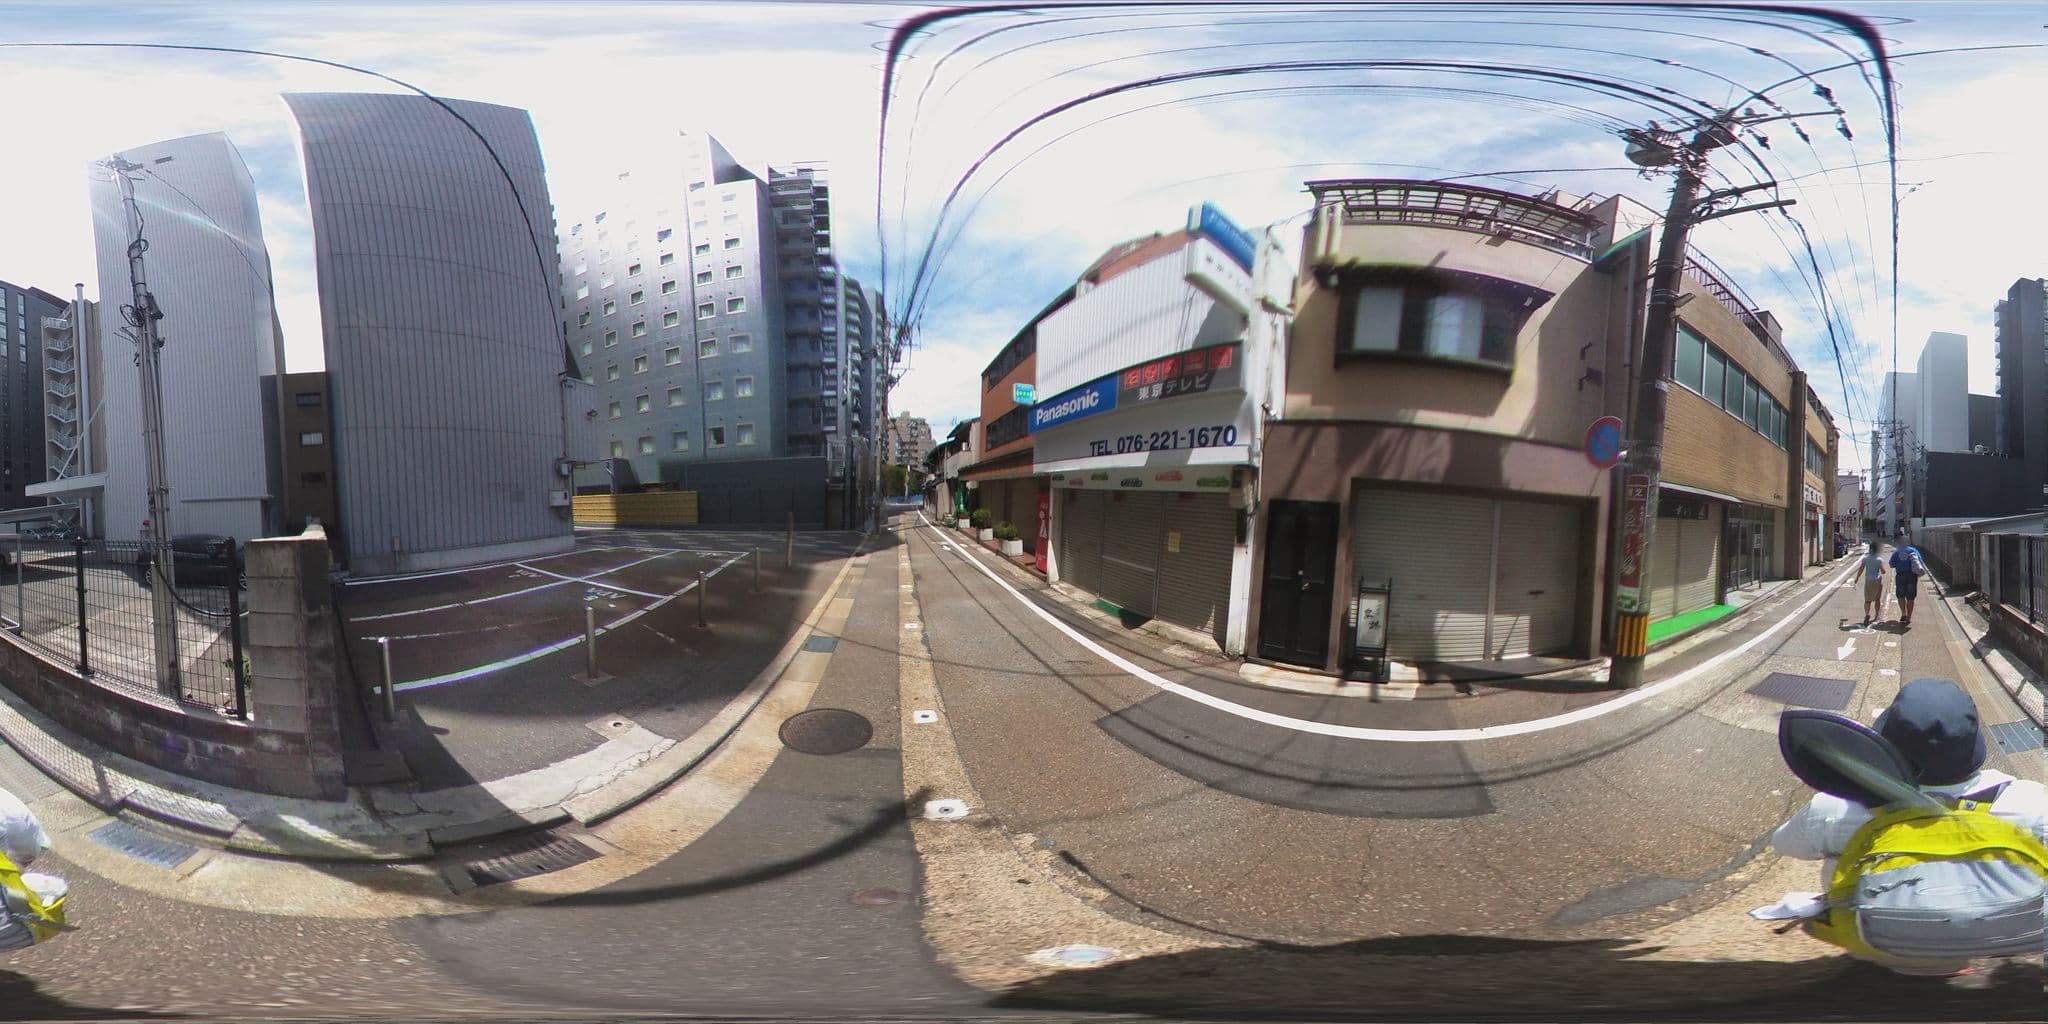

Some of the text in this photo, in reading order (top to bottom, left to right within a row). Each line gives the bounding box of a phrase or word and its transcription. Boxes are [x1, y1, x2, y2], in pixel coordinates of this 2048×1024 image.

[1138, 373, 1209, 401] 東京テレビ
[1036, 389, 1100, 426] Panasonic
[1090, 424, 1238, 457] TEL 076-221-1670
